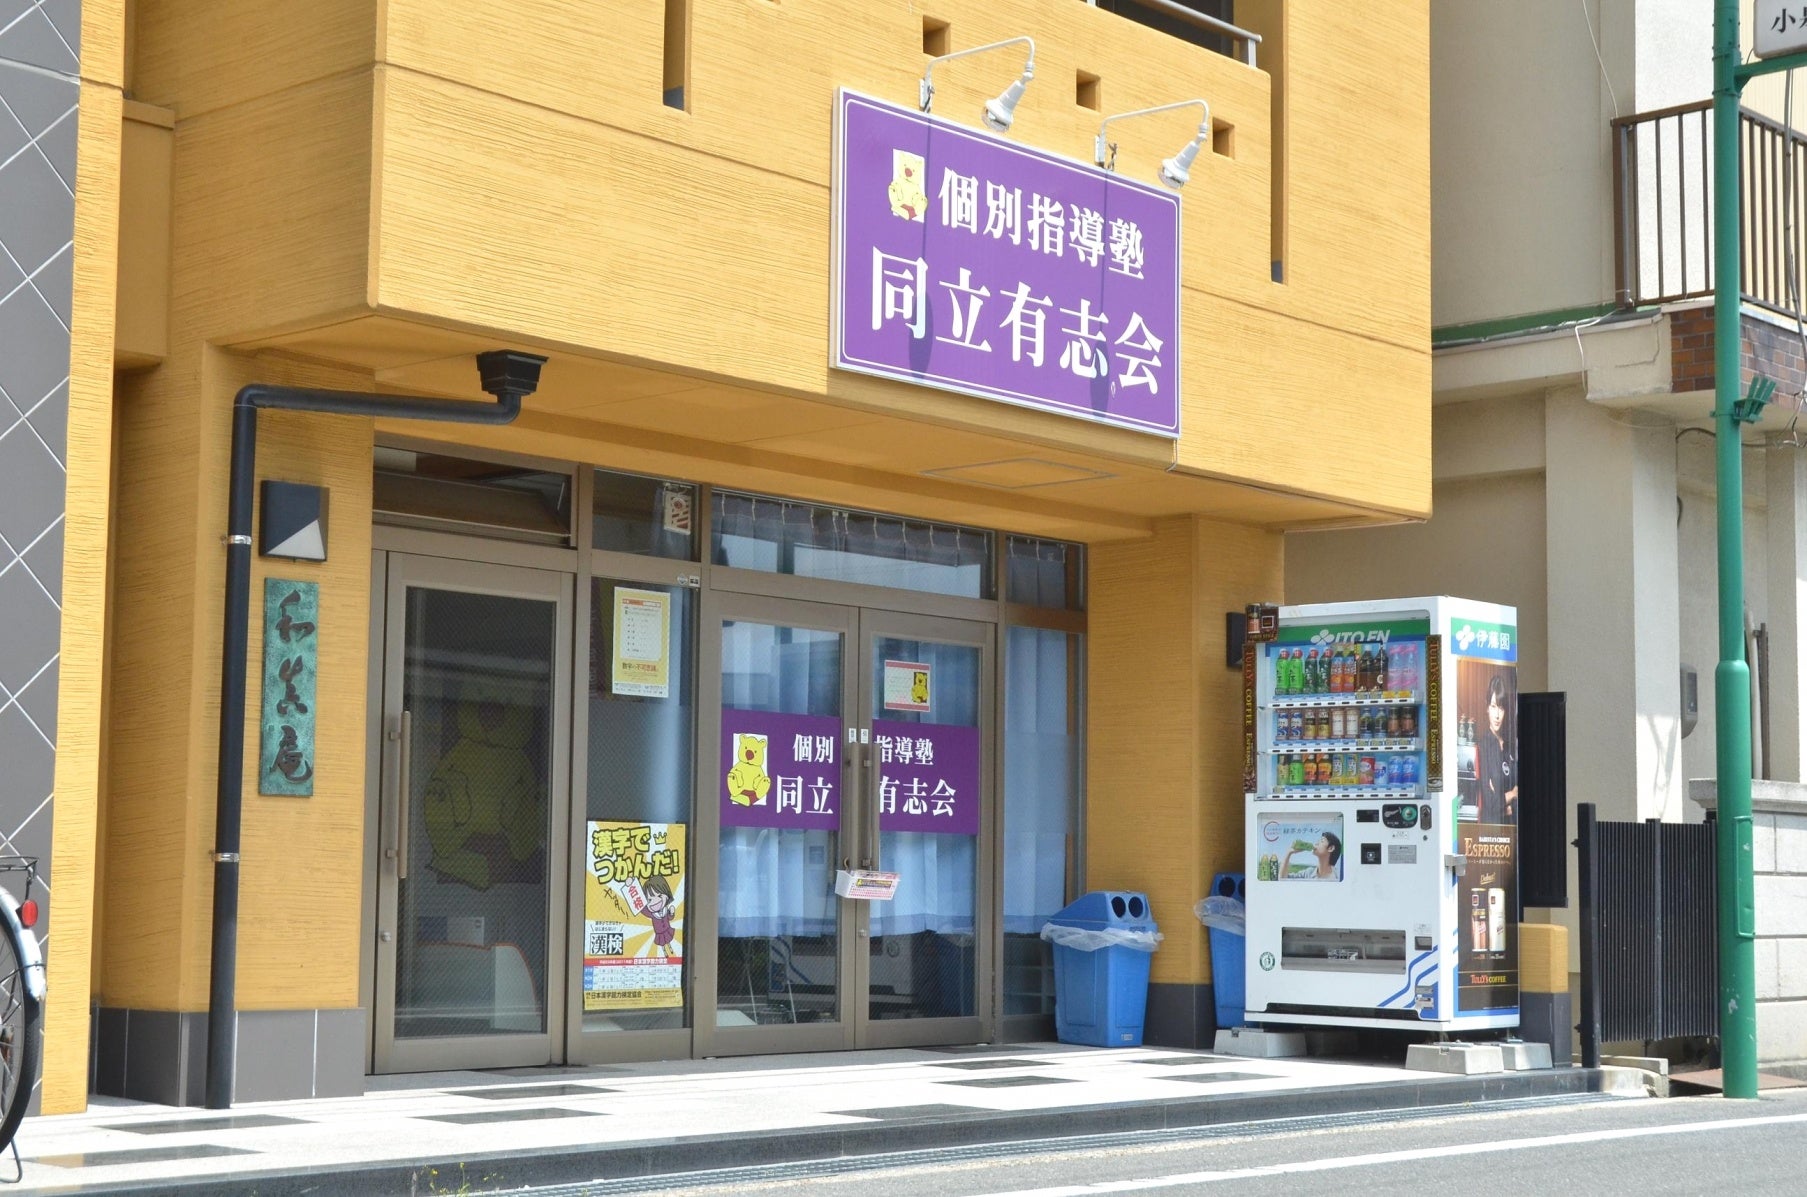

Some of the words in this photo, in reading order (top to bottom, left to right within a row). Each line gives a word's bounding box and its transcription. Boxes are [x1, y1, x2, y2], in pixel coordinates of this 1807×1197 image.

[938, 166, 1145, 280] 個別指導塾
[871, 246, 1164, 395] 同立有志会
[1476, 629, 1510, 651] 伊藤園
[793, 733, 834, 764] 個別
[874, 735, 934, 766] 指導塾
[776, 775, 834, 815] 同立
[879, 775, 956, 817] 有志会
[592, 826, 651, 858] 漢字で
[1464, 838, 1510, 857] ESPRESSO
[590, 933, 623, 955] 漢検
[1488, 975, 1507, 983] COFFEE
